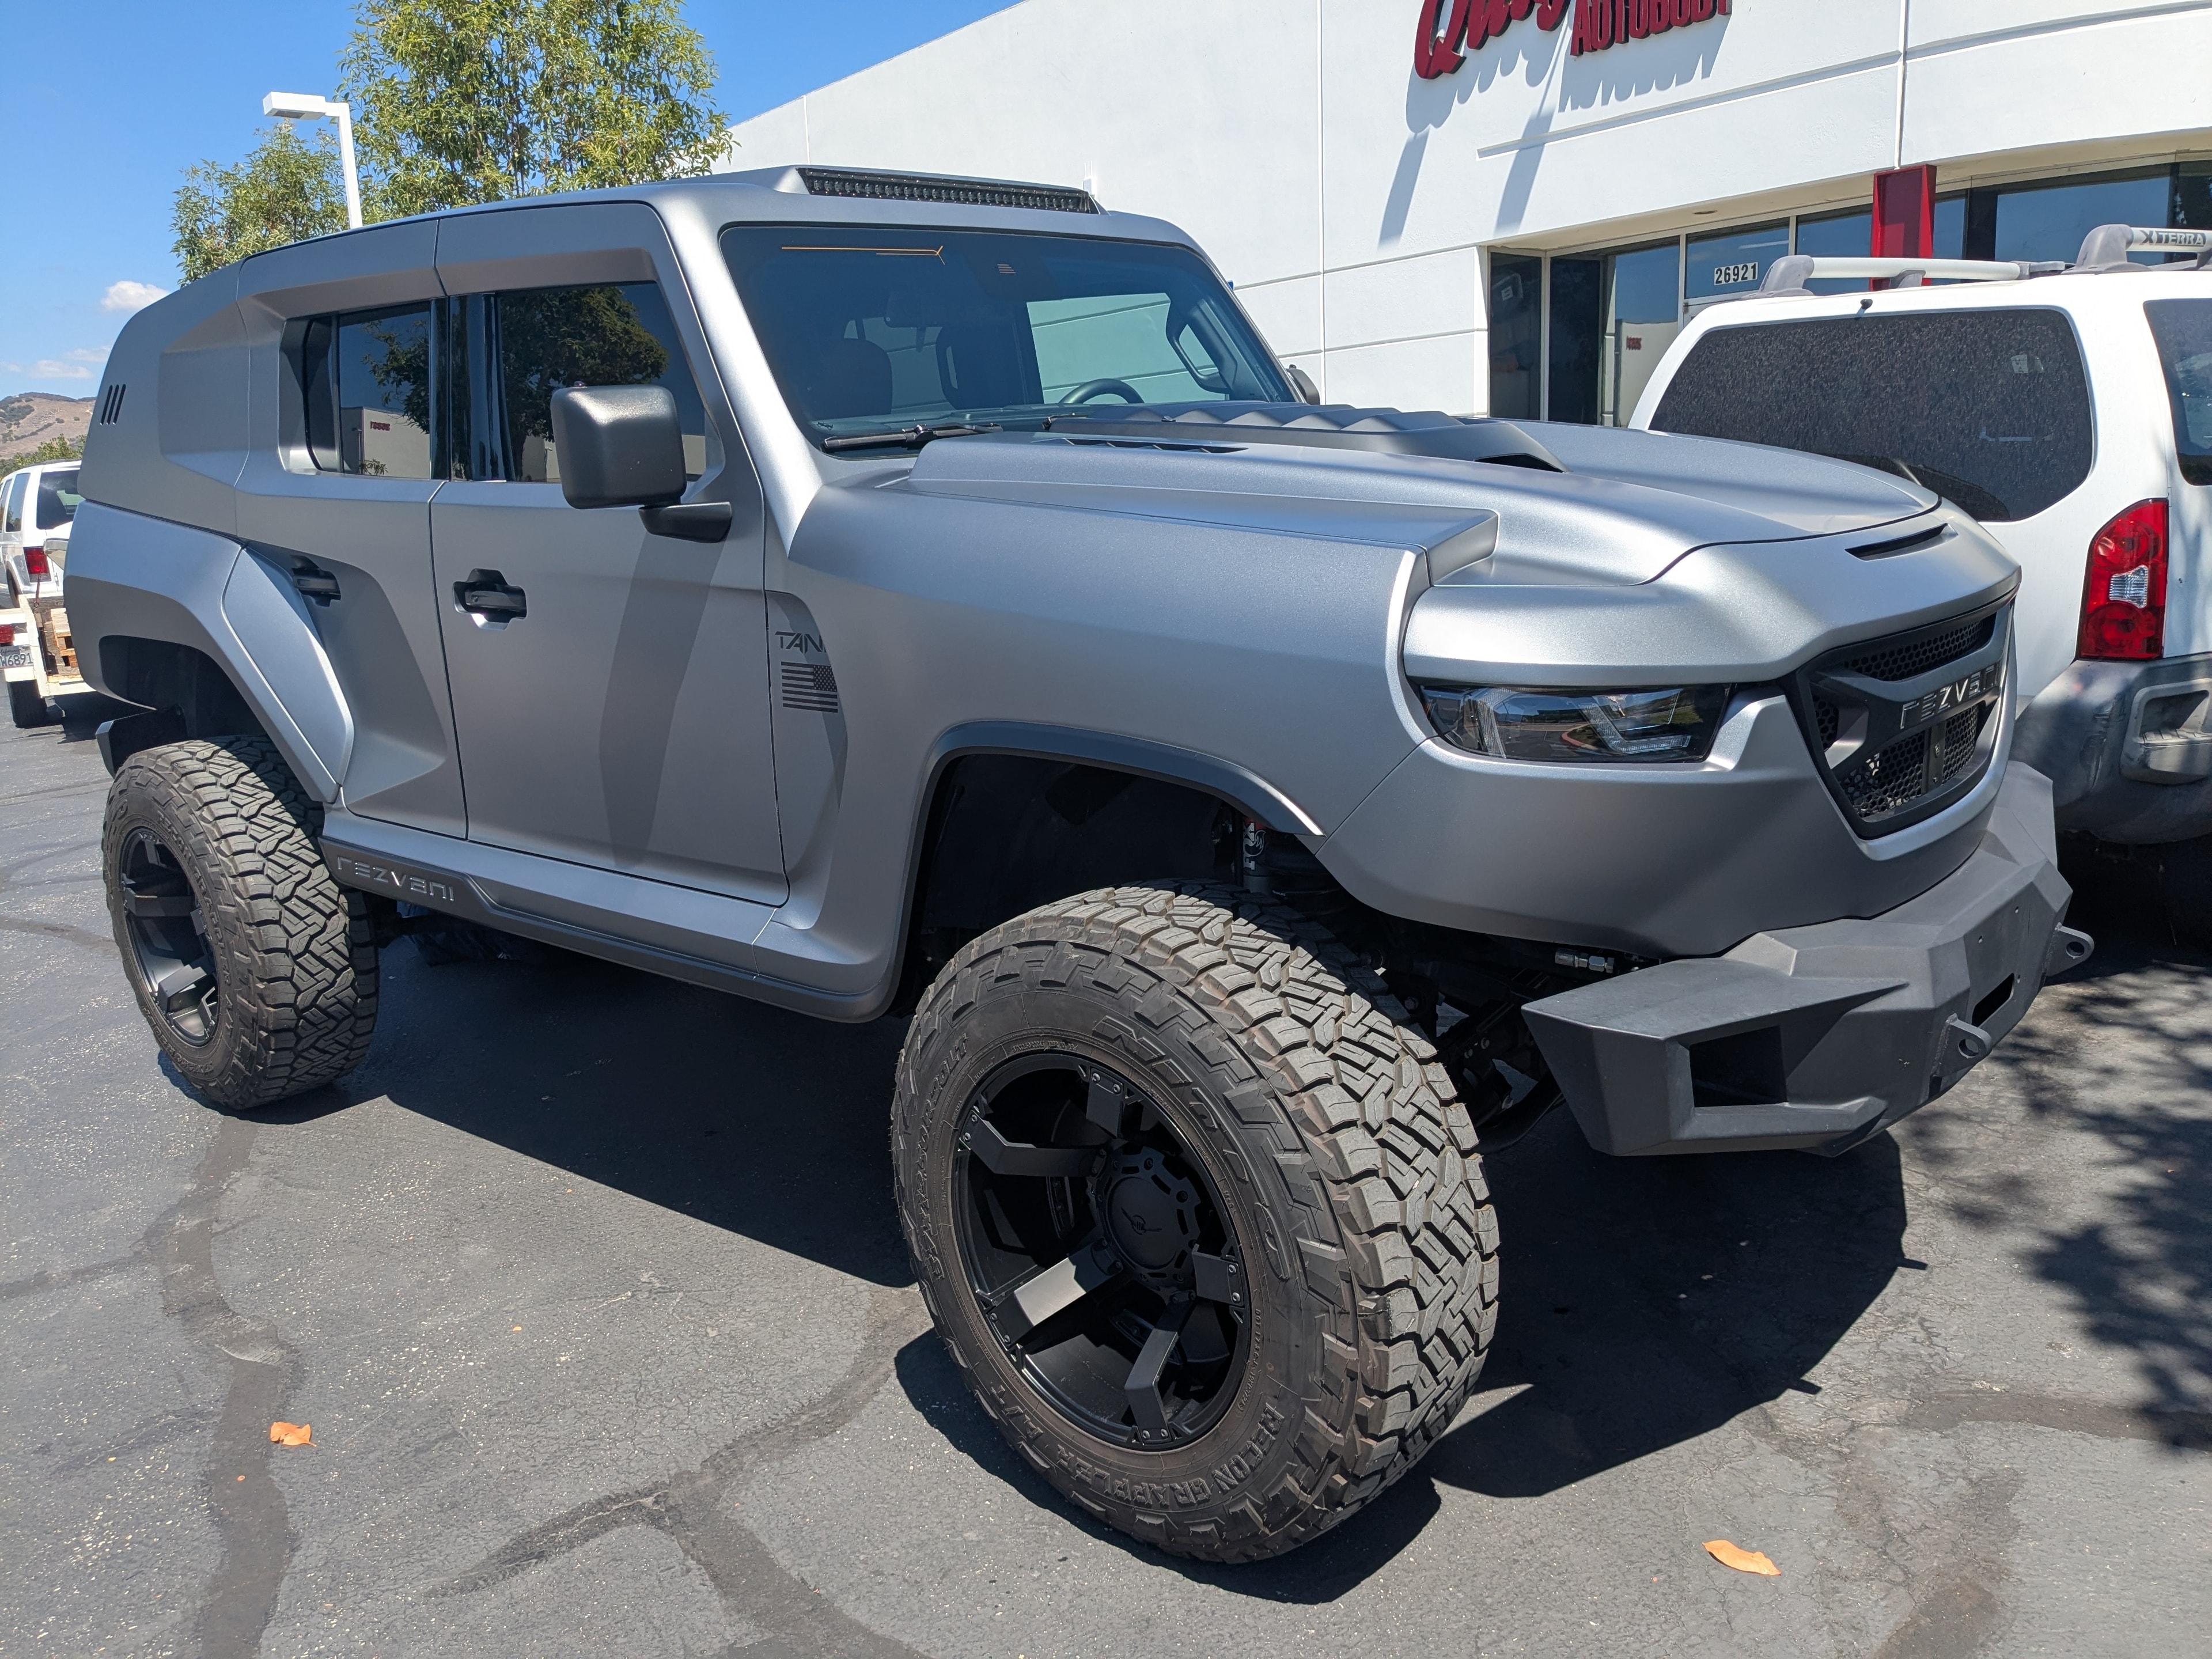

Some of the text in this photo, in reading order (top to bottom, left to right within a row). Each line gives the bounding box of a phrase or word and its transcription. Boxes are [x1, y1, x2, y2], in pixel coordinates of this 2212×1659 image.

[2139, 230, 2206, 247] XTERRA
[1715, 263, 1756, 285] 26921
[775, 631, 827, 654] TAN
[337, 856, 454, 902] REZVANI
[1211, 1402, 1285, 1493] RECON
[1056, 1444, 1213, 1505] GRAPPLER
